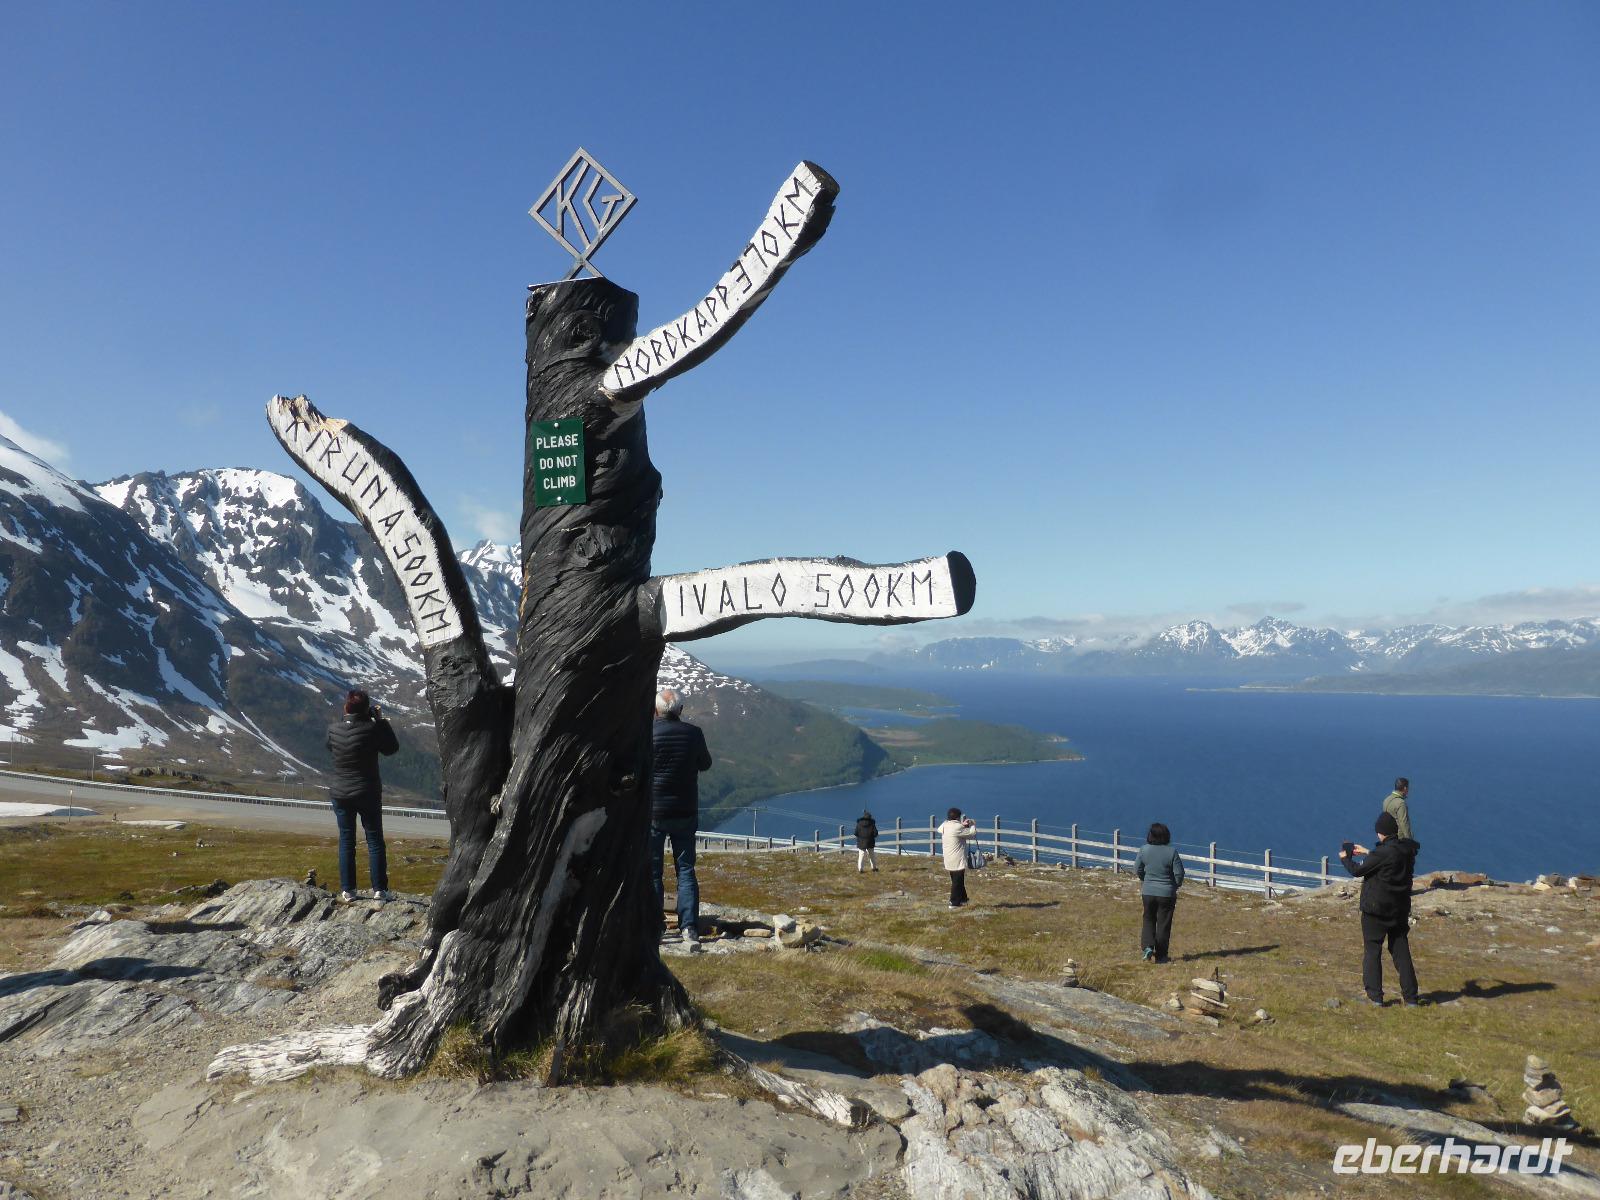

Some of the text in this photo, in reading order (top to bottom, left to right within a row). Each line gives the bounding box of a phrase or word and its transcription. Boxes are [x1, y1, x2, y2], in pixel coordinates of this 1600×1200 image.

[536, 433, 579, 450] PLEASE
[539, 454, 578, 470] DO NOT
[543, 475, 576, 490] CLIMB
